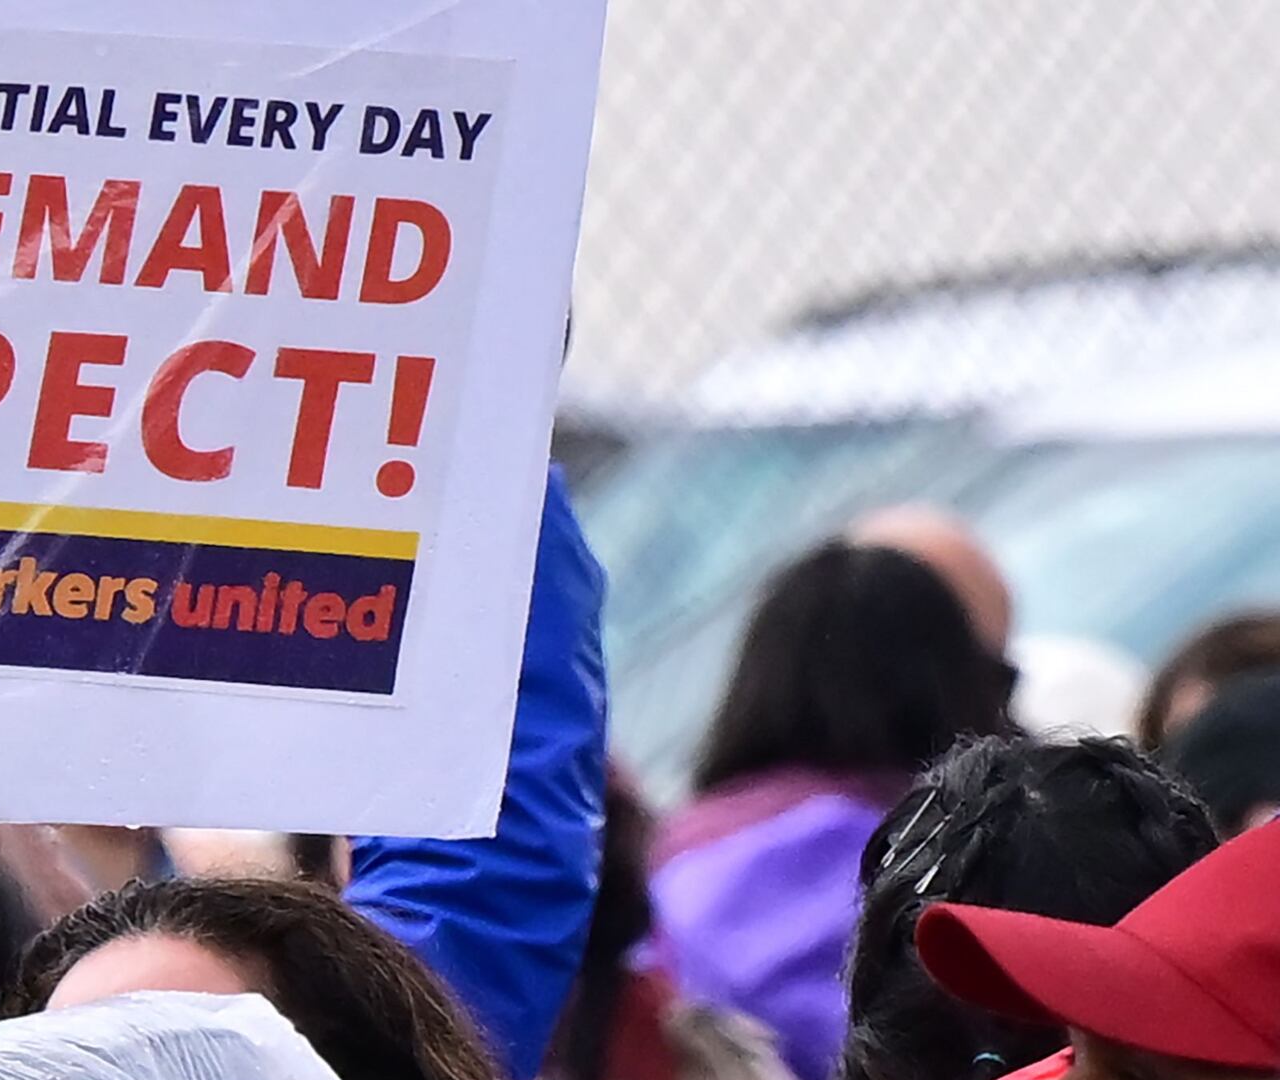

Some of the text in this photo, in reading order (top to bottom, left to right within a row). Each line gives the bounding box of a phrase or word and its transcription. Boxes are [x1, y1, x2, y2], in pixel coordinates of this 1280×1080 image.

[148, 92, 342, 152] EVERY
[359, 105, 492, 161] DAY
[170, 570, 396, 642] united
